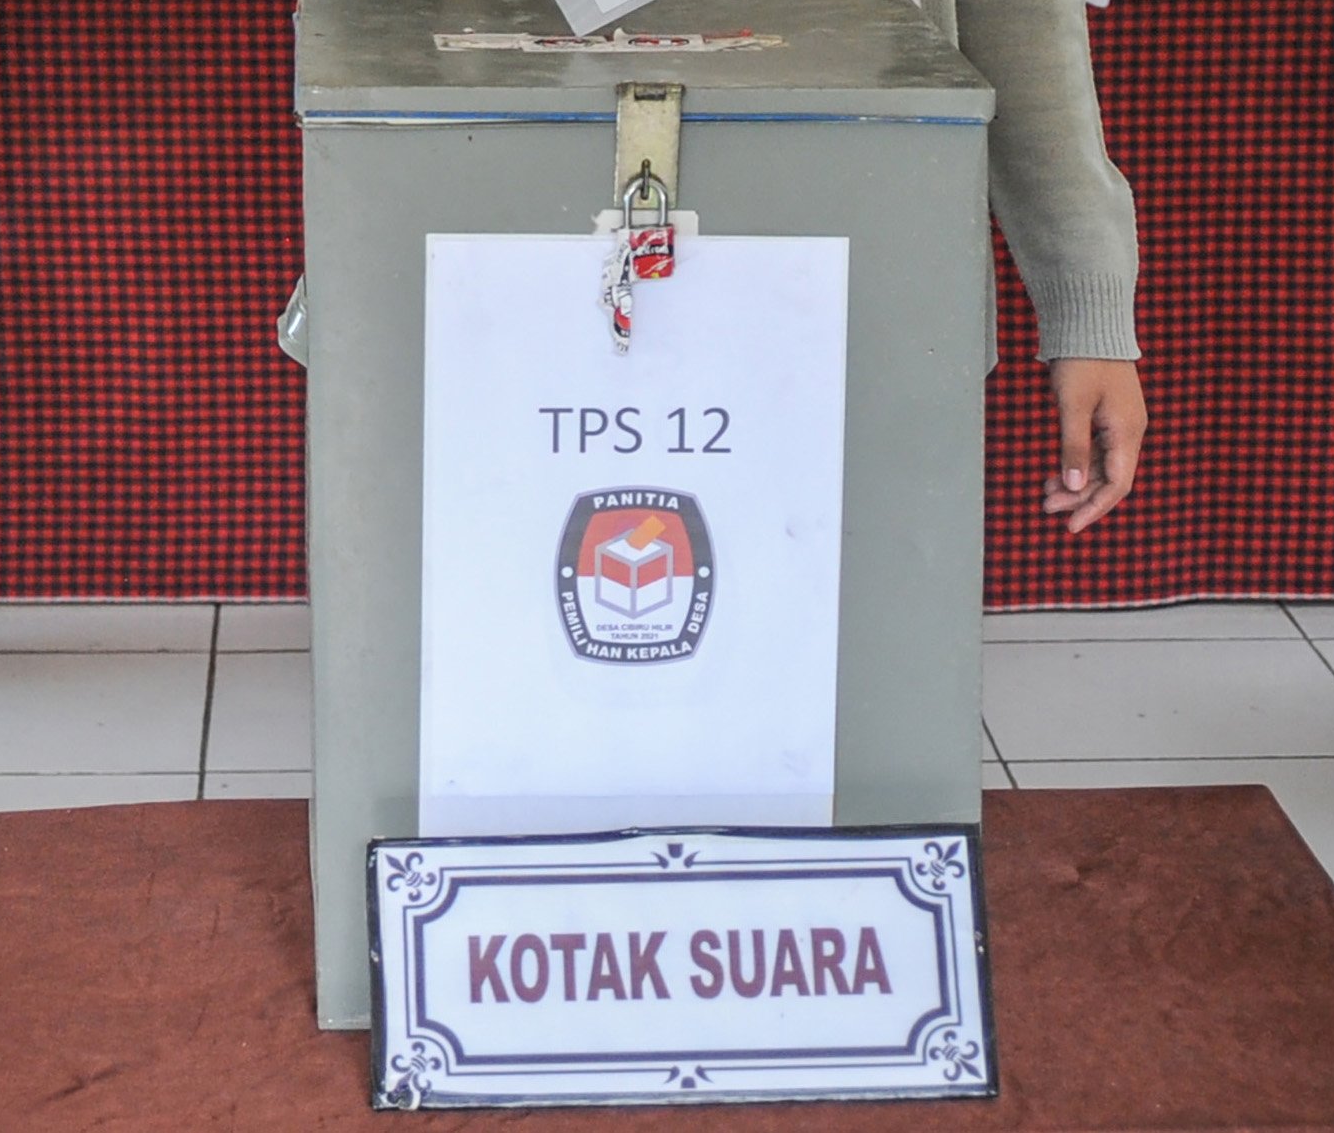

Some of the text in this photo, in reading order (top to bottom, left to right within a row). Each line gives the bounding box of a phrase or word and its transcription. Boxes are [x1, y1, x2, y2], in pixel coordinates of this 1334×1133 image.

[538, 406, 732, 455] TPS 12
[592, 491, 679, 511] PANITIA
[626, 639, 693, 660] KEPALA
[687, 590, 709, 634] DESA
[467, 925, 894, 1005] KOTAK SUARA
